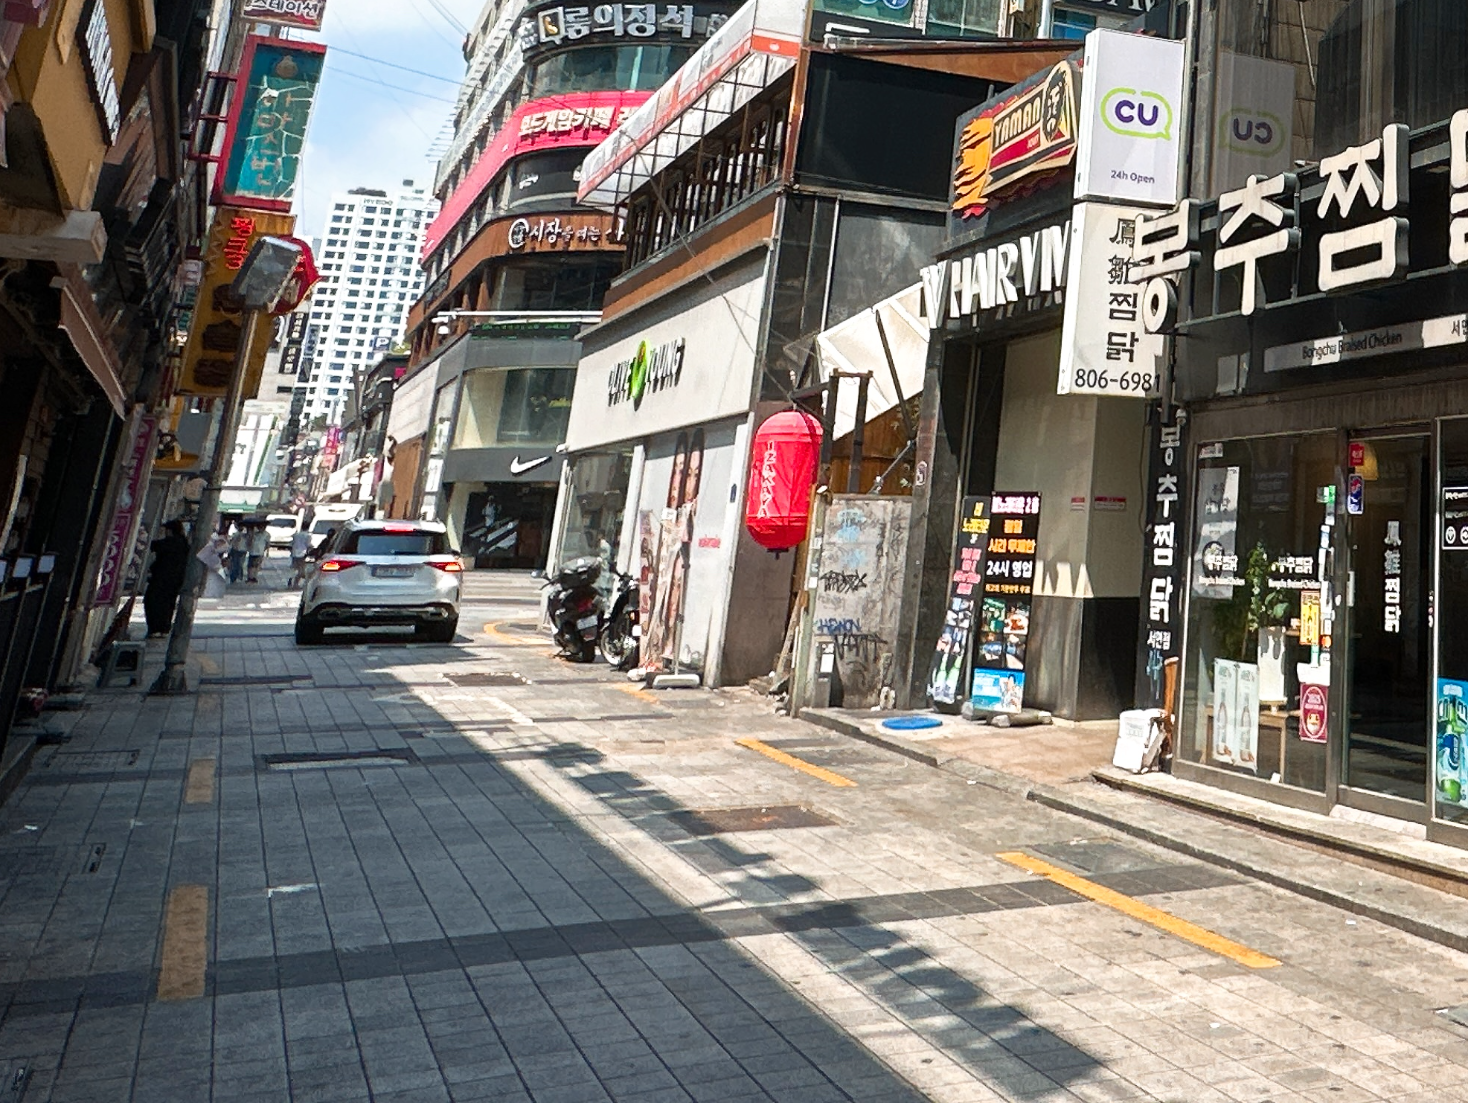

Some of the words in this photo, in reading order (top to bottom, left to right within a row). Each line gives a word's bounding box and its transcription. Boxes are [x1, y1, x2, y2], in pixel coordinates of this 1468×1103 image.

[994, 96, 1041, 148] YAMAN
[1113, 99, 1159, 127] CU
[1110, 169, 1129, 183] 24h
[1130, 172, 1156, 185] Open
[1074, 368, 1161, 393] 806-6981
[1150, 424, 1181, 624] 봉추찜닭
[986, 560, 1010, 578] 24시
[1011, 560, 1033, 579] 영업
